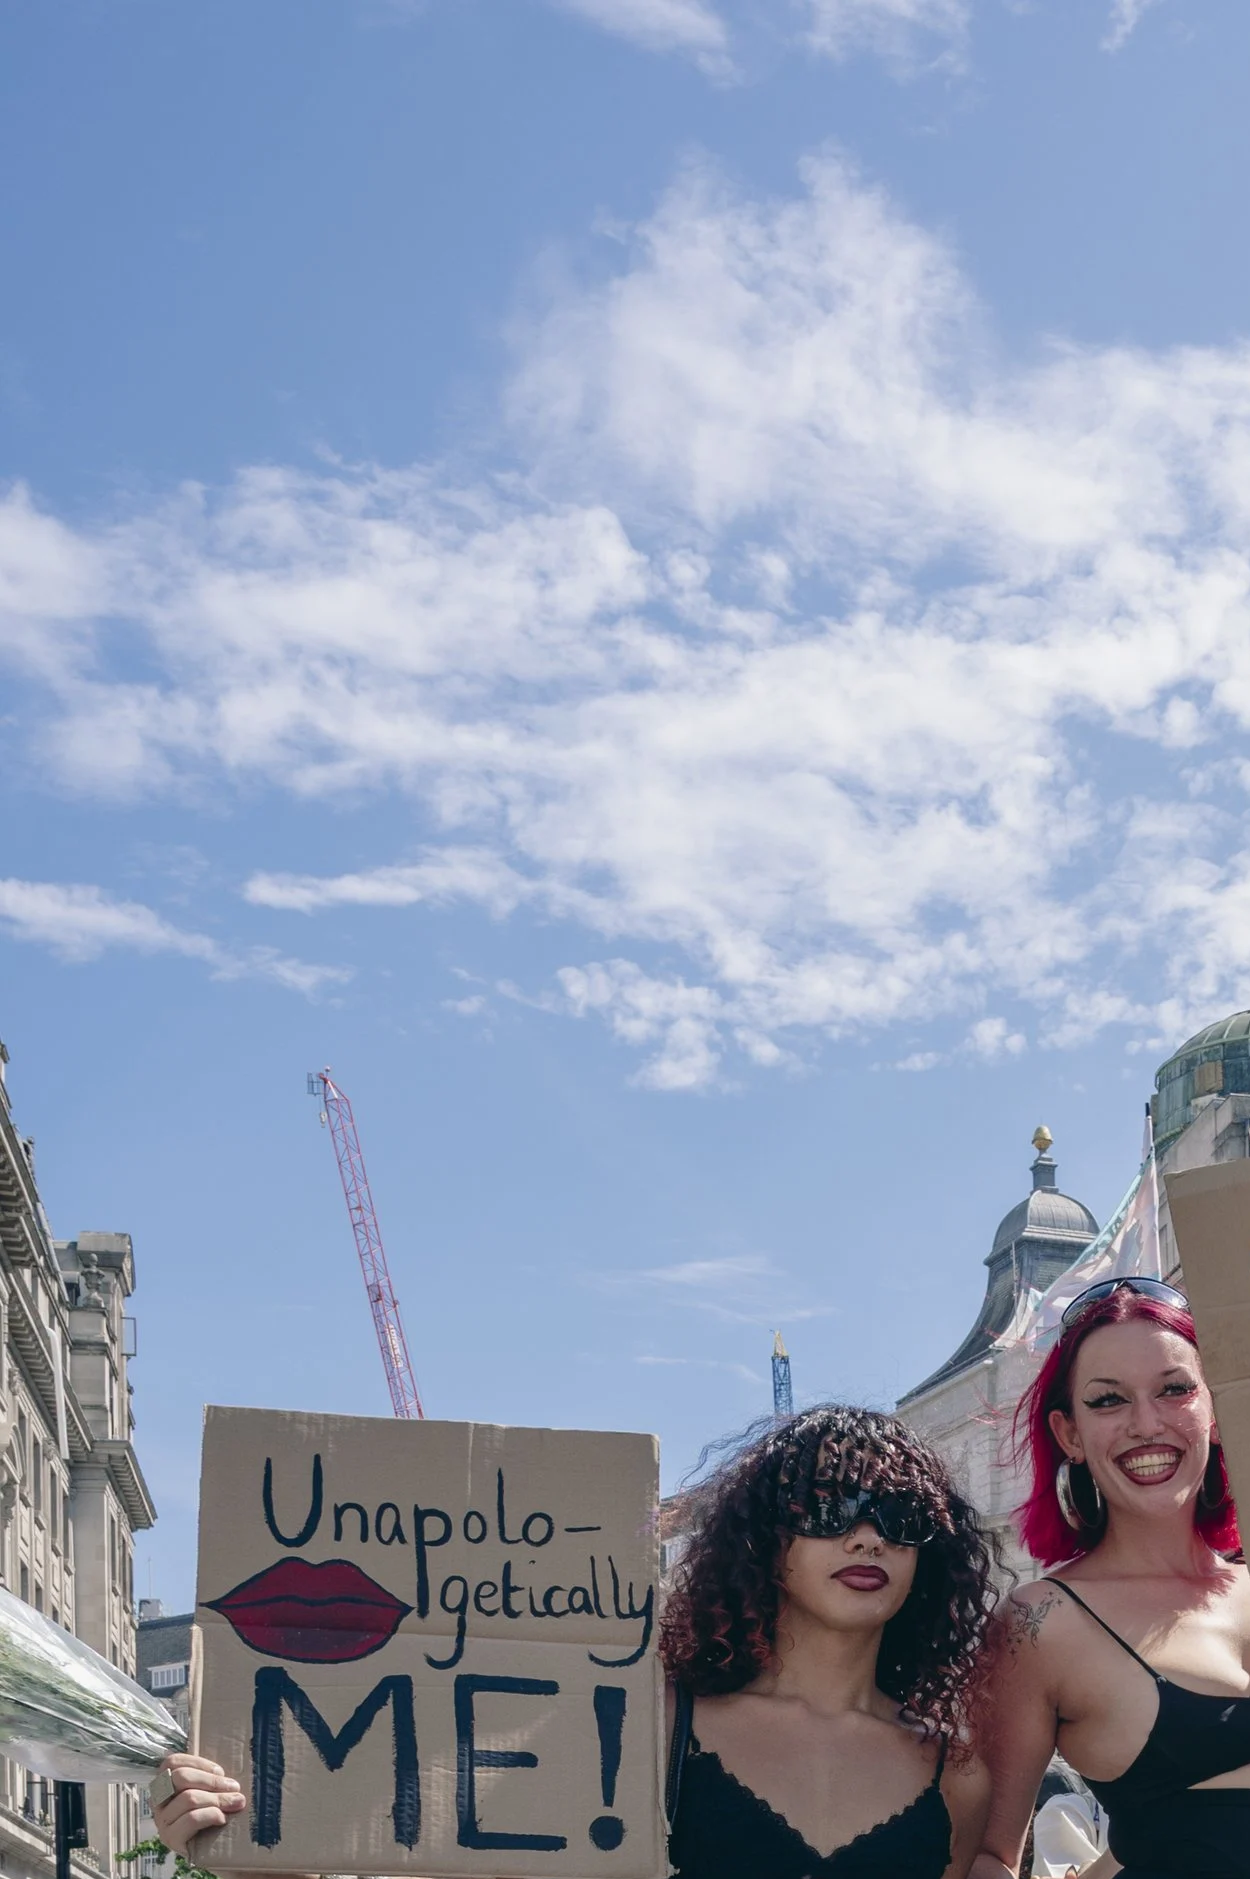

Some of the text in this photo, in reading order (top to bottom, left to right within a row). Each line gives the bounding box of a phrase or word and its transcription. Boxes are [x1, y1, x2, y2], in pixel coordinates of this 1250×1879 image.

[262, 1454, 602, 1619] Unapolo-
[424, 1555, 655, 1670] getically
[249, 1666, 629, 1852] ME!
